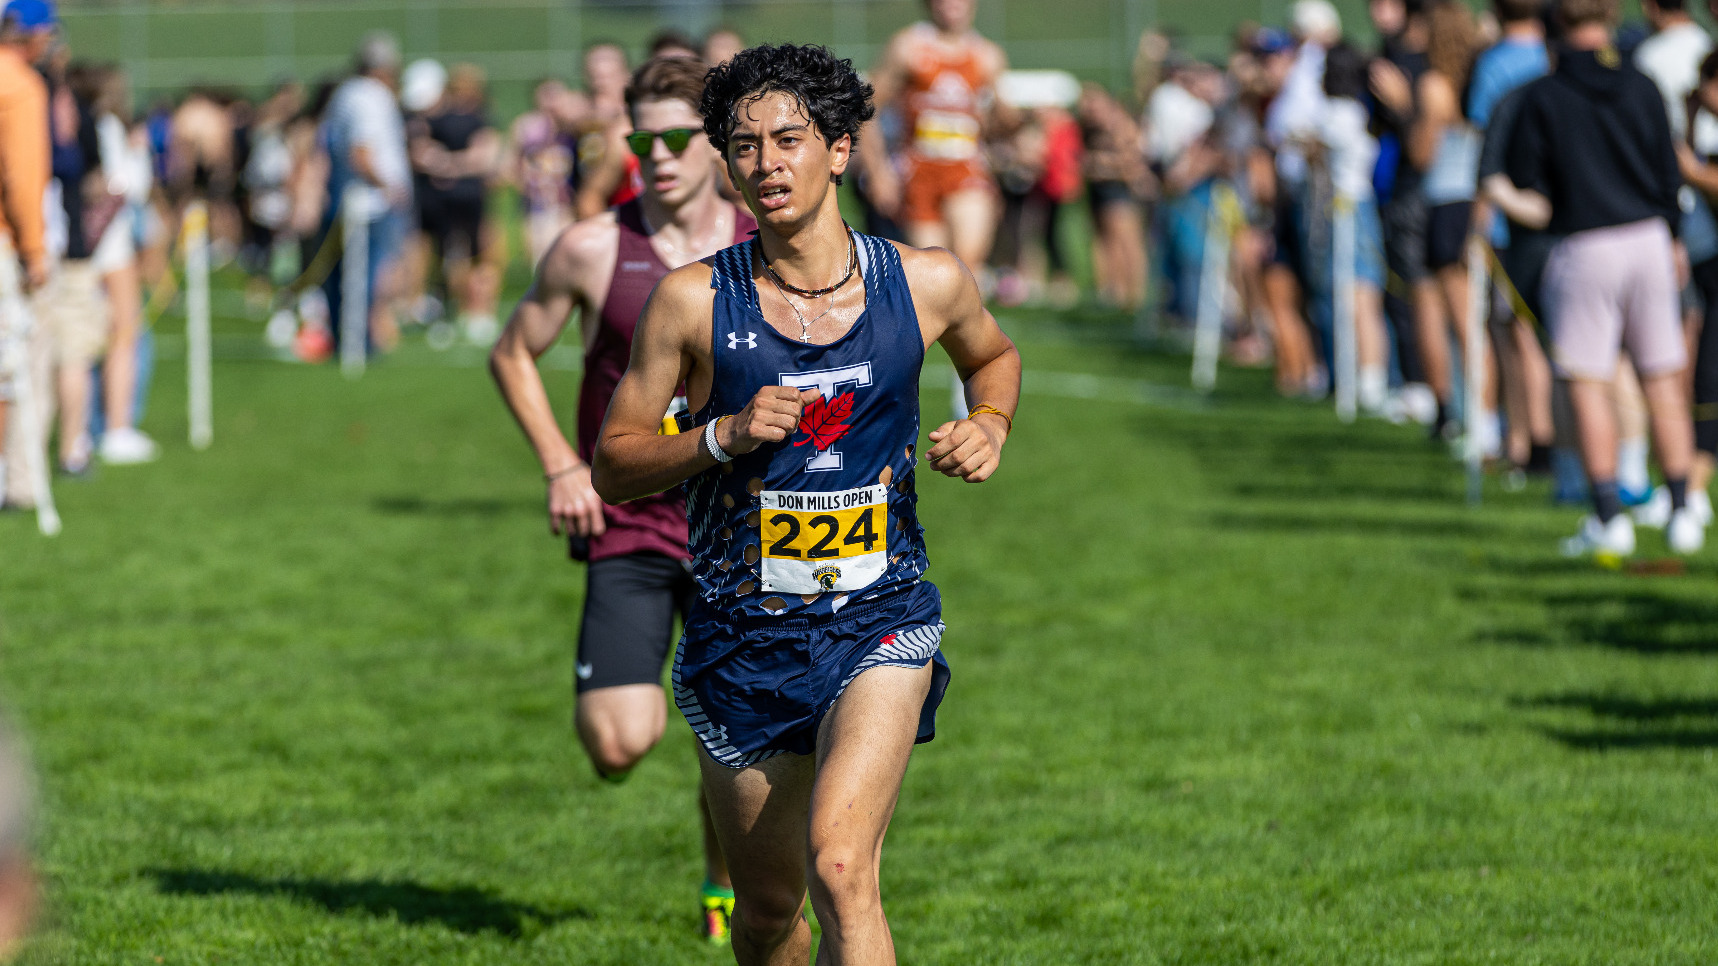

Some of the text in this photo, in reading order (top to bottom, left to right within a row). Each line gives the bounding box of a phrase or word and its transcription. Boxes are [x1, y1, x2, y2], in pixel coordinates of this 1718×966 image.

[779, 361, 873, 473] T
[778, 490, 873, 510] DON MILLS OPEN
[769, 508, 878, 558] 224
